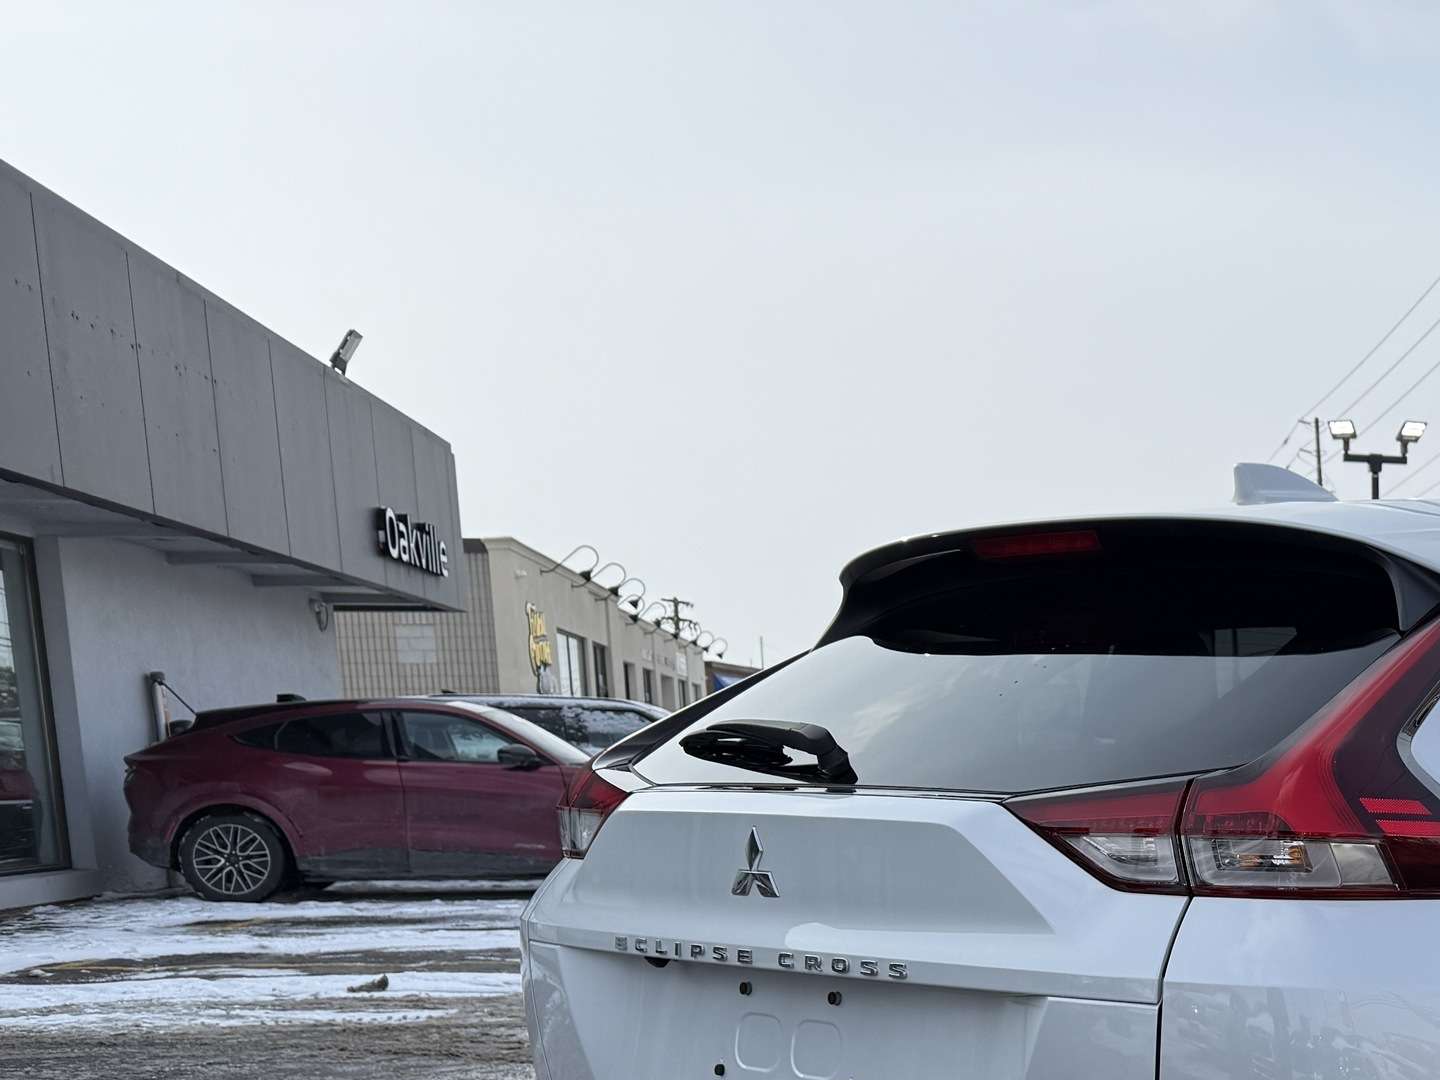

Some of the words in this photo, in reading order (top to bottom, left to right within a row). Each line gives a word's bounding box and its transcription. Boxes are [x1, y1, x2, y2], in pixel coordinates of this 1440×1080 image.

[385, 507, 449, 578] Oakville
[614, 936, 753, 965] ECLIPSE
[778, 952, 909, 980] CROSS
